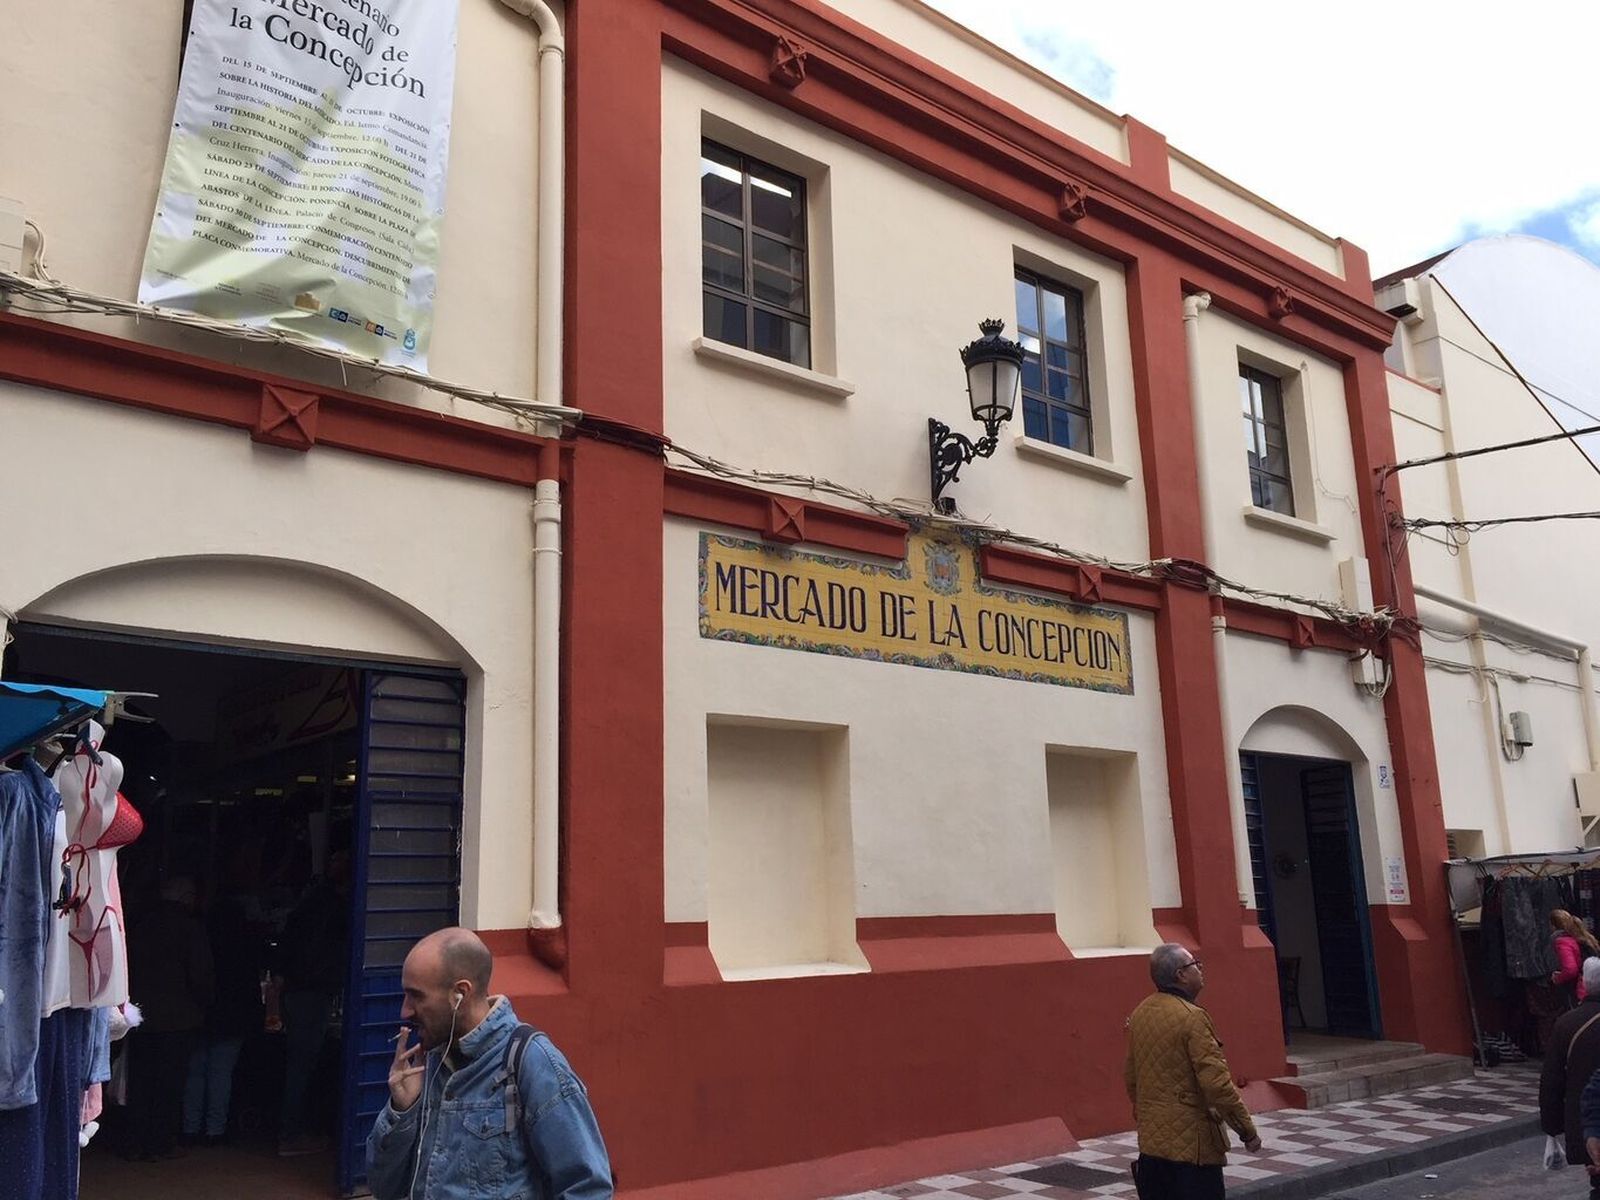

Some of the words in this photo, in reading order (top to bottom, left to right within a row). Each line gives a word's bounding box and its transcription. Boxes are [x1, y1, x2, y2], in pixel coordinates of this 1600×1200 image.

[222, 56, 239, 65] DEL
[243, 60, 252, 68] 15
[256, 64, 267, 74] DE
[270, 71, 318, 95] SEPTIEMBRE
[229, 8, 252, 30] la
[265, 14, 425, 99] Concepción
[381, 46, 409, 62] de
[219, 72, 247, 84] SOBRE
[247, 78, 259, 88] LA
[260, 82, 298, 103] HISTORIA
[298, 98, 314, 110] DEL
[214, 104, 266, 123] SEPTIEMBRE
[267, 119, 278, 128] AL
[278, 123, 287, 132] 21
[288, 126, 298, 137] DE
[274, 105, 302, 122] viernes
[395, 145, 408, 156] DEL
[410, 151, 417, 160] 21
[209, 136, 230, 148] Cruz
[338, 172, 347, 180] 21
[211, 120, 227, 130] DEL
[229, 124, 283, 146] CENTENARIO
[283, 141, 295, 153] DEL
[342, 159, 353, 167] LA
[200, 183, 240, 198] ABASTOS
[243, 194, 254, 203] DE
[254, 199, 262, 209] LA
[327, 212, 337, 221] de
[232, 175, 244, 183] DE
[246, 178, 257, 188] LA
[309, 198, 351, 211] PONENCIA
[354, 206, 377, 220] SOBRE
[378, 215, 387, 225] LA
[388, 220, 409, 234] PLAZA
[243, 160, 253, 169] 23
[254, 163, 265, 174] DE
[319, 185, 360, 197] JORNADAS
[402, 209, 412, 219] DE
[195, 214, 212, 223] DEL
[214, 219, 254, 239] MERCADO
[243, 212, 253, 222] DE
[192, 229, 218, 244] PLACA
[297, 251, 329, 268] Mercado
[331, 262, 340, 272] de
[341, 265, 348, 274] la
[715, 561, 867, 633] MERCADO
[879, 590, 917, 641] DE
[927, 599, 968, 649] LA
[977, 608, 1123, 673] CONCEPCION
